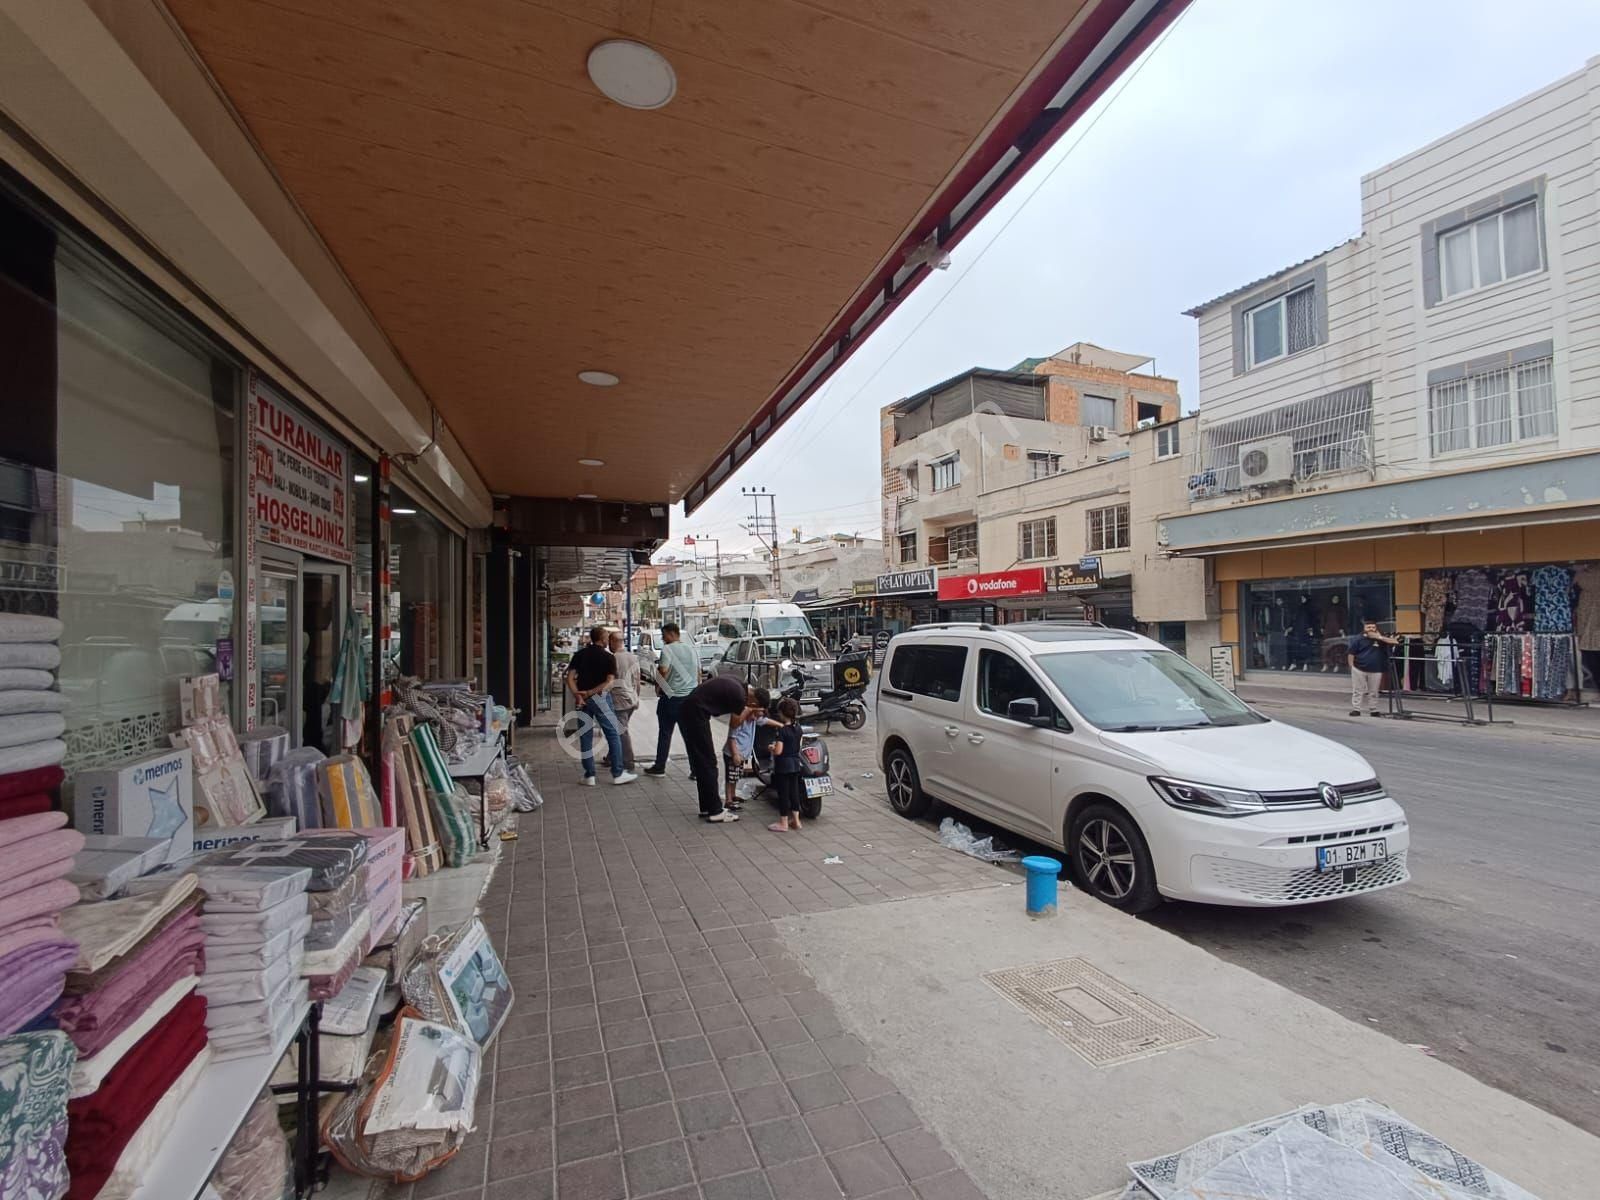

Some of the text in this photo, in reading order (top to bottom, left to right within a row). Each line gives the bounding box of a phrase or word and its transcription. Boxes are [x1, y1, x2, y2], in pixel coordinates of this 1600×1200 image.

[256, 396, 343, 477] TURANLAR
[257, 492, 345, 548] HOŞGELDİNİZ
[979, 579, 1017, 592] vodafone
[145, 757, 183, 781] merinos
[1325, 842, 1384, 864] 01 BZM 73
